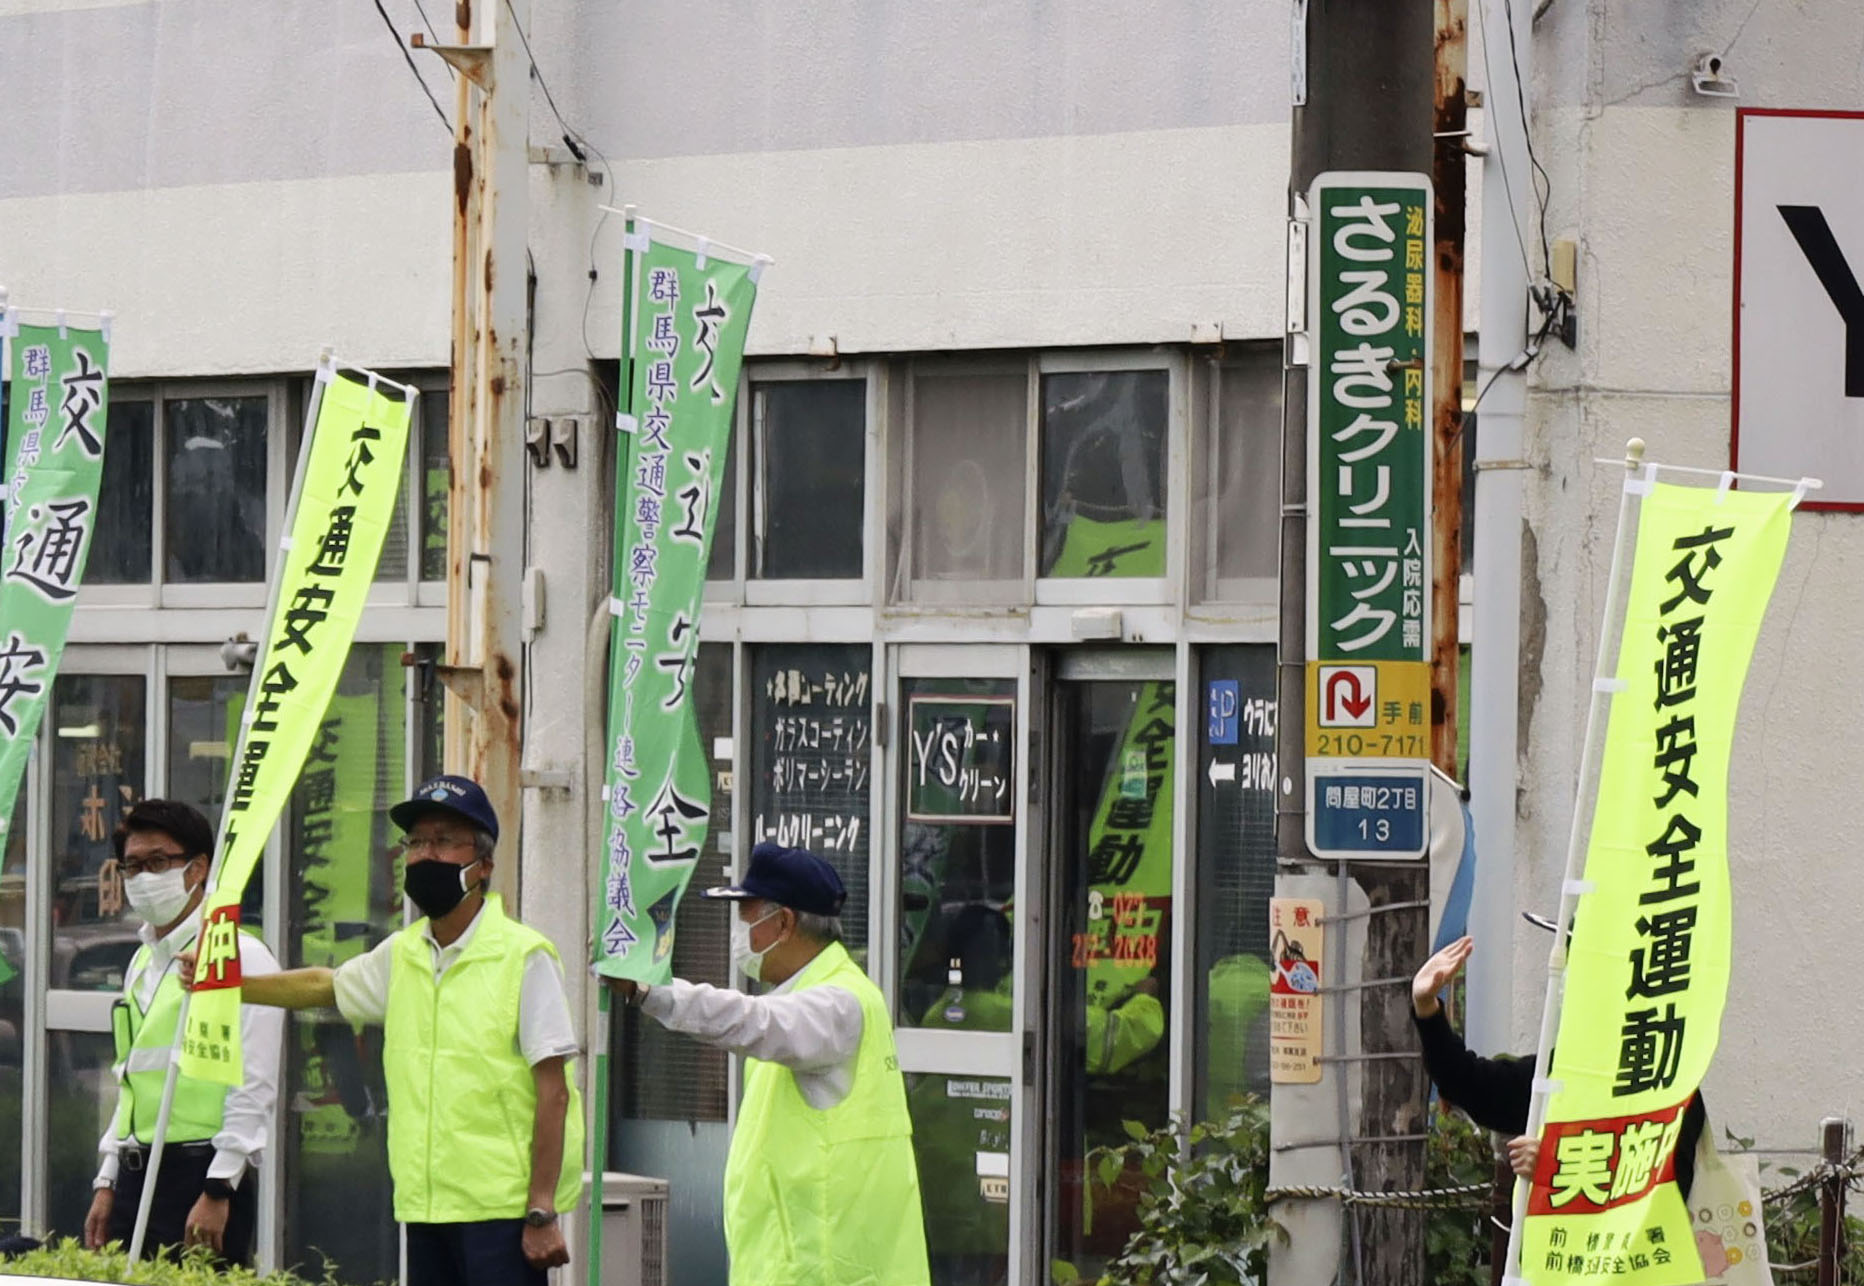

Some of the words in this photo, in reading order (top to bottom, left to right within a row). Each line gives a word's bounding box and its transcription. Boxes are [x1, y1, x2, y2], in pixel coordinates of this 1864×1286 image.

[1331, 195, 1400, 652] さるきクリニック
[1402, 528, 1422, 649] 入院応需
[1382, 701, 1423, 725] 手前
[1317, 735, 1424, 757] 210-7171
[959, 767, 1006, 802] クリーン
[1326, 786, 1416, 811] 問屋町2丁目
[1612, 526, 1736, 1098] 交通安全運動
[754, 813, 861, 852] ルームクリーニング
[1358, 818, 1390, 842] 13
